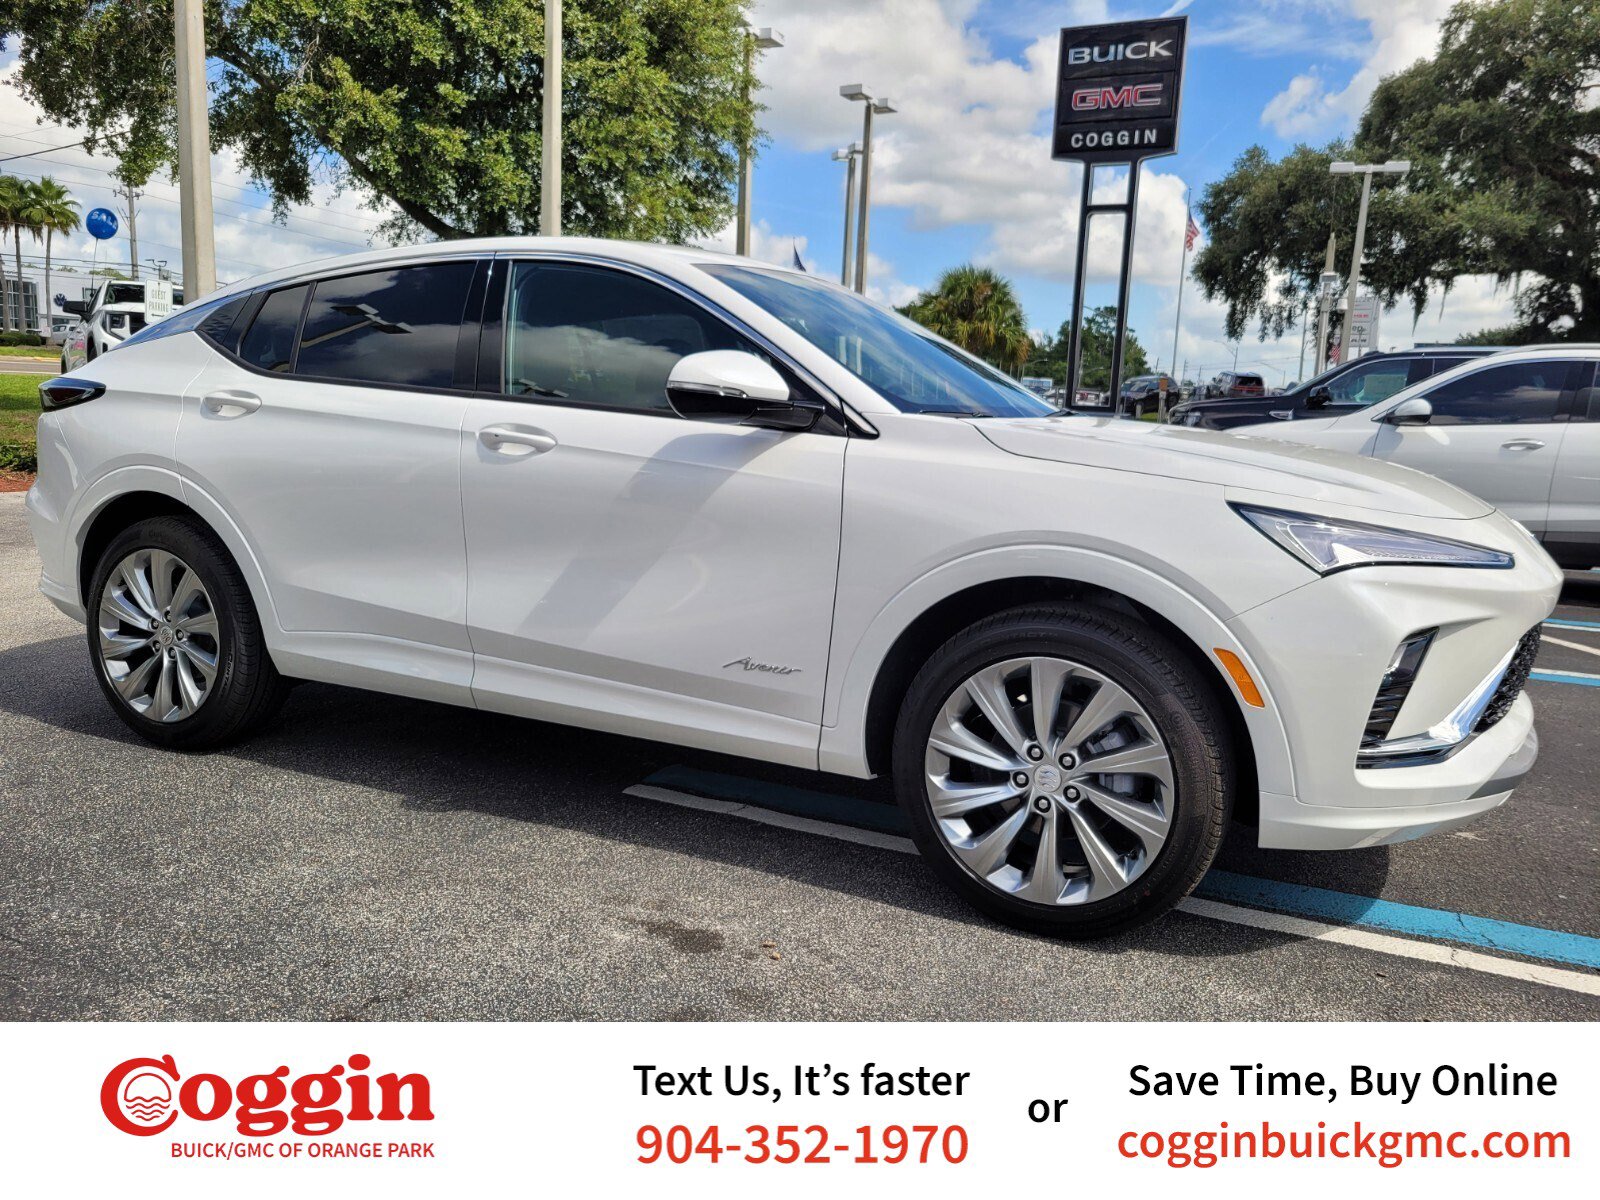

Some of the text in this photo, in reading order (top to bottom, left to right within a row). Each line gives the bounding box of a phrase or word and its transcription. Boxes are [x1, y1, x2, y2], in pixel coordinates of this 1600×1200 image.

[1068, 39, 1173, 65] BUICK
[1071, 83, 1163, 111] GMC
[1070, 128, 1157, 148] COGGIN
[151, 289, 166, 300] GUEST
[148, 301, 169, 312] PARKING
[722, 656, 802, 675] Avenir
